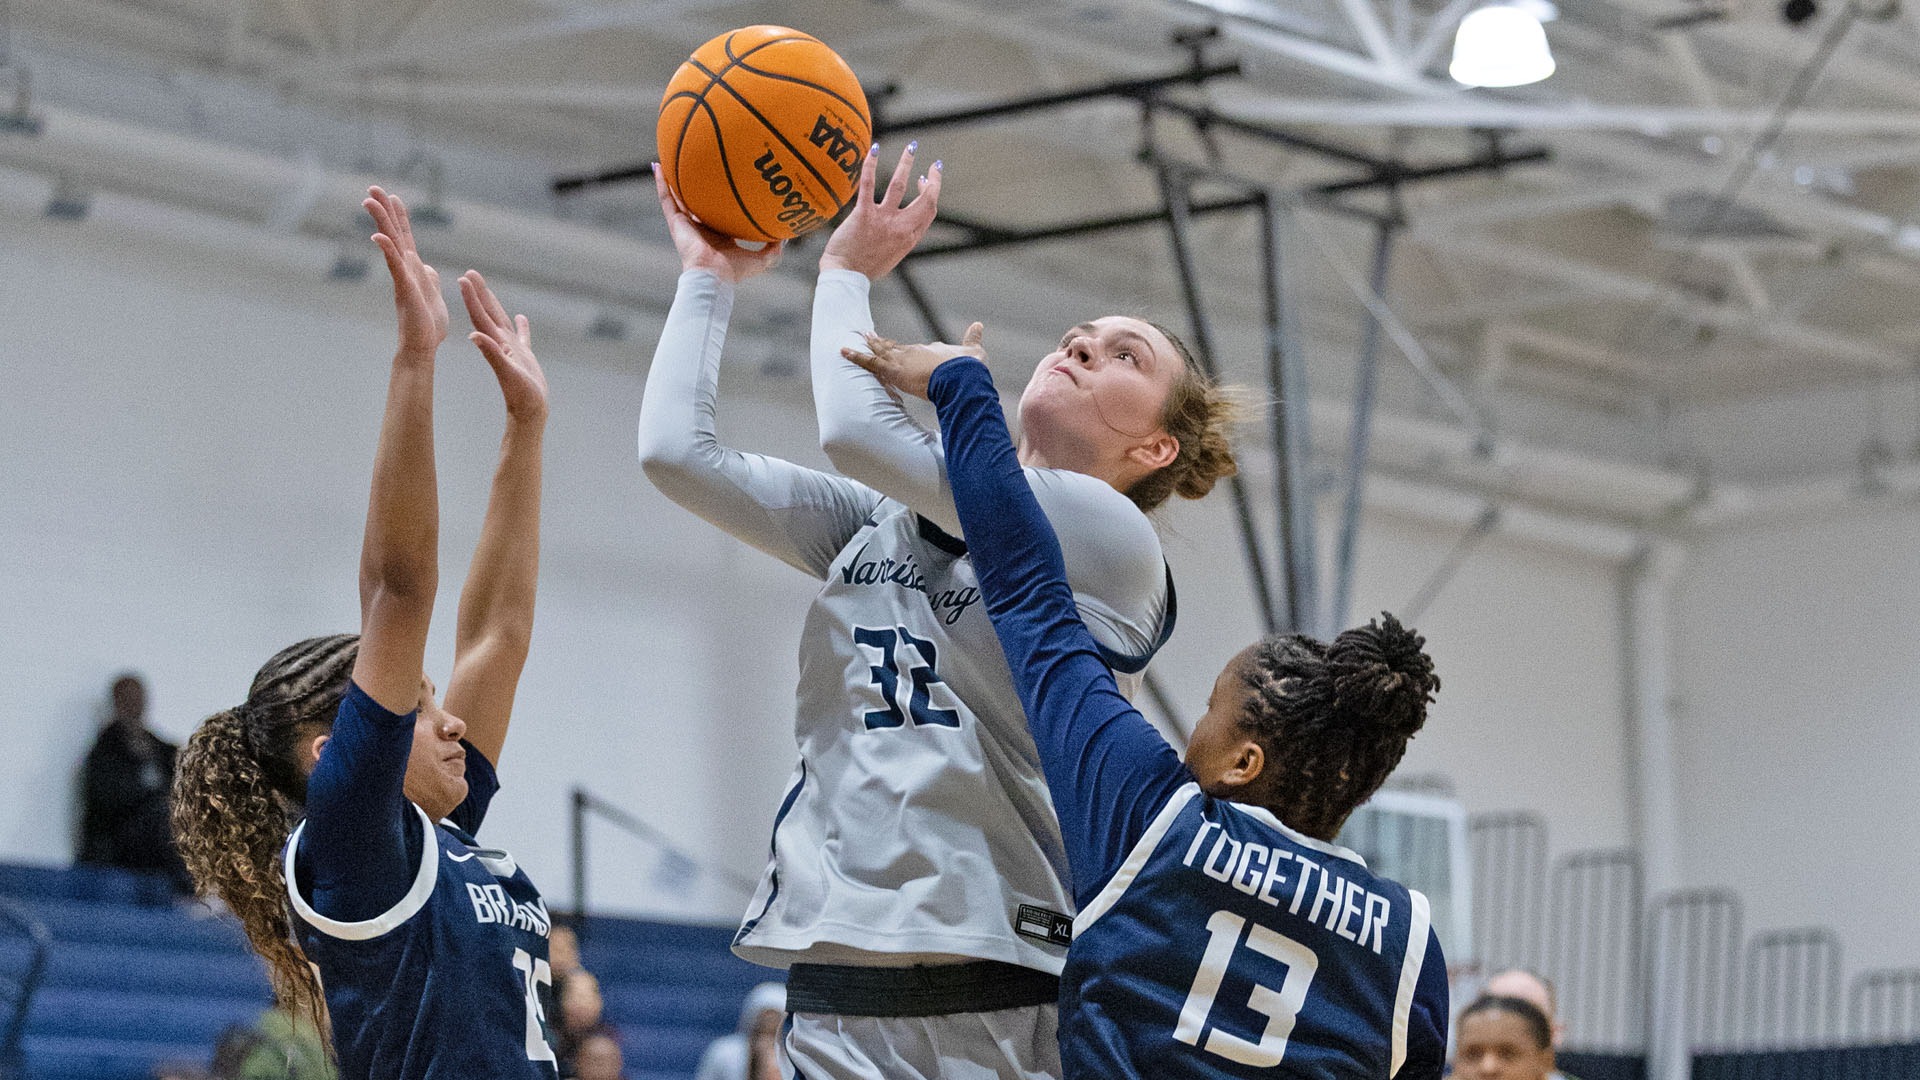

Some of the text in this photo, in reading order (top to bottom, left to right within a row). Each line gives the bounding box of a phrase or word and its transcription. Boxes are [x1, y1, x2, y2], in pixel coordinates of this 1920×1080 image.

[852, 623, 962, 731] 32
[1054, 922, 1069, 938] XL
[1183, 811, 1391, 955] TOGETHER
[1172, 909, 1319, 1068] 13
